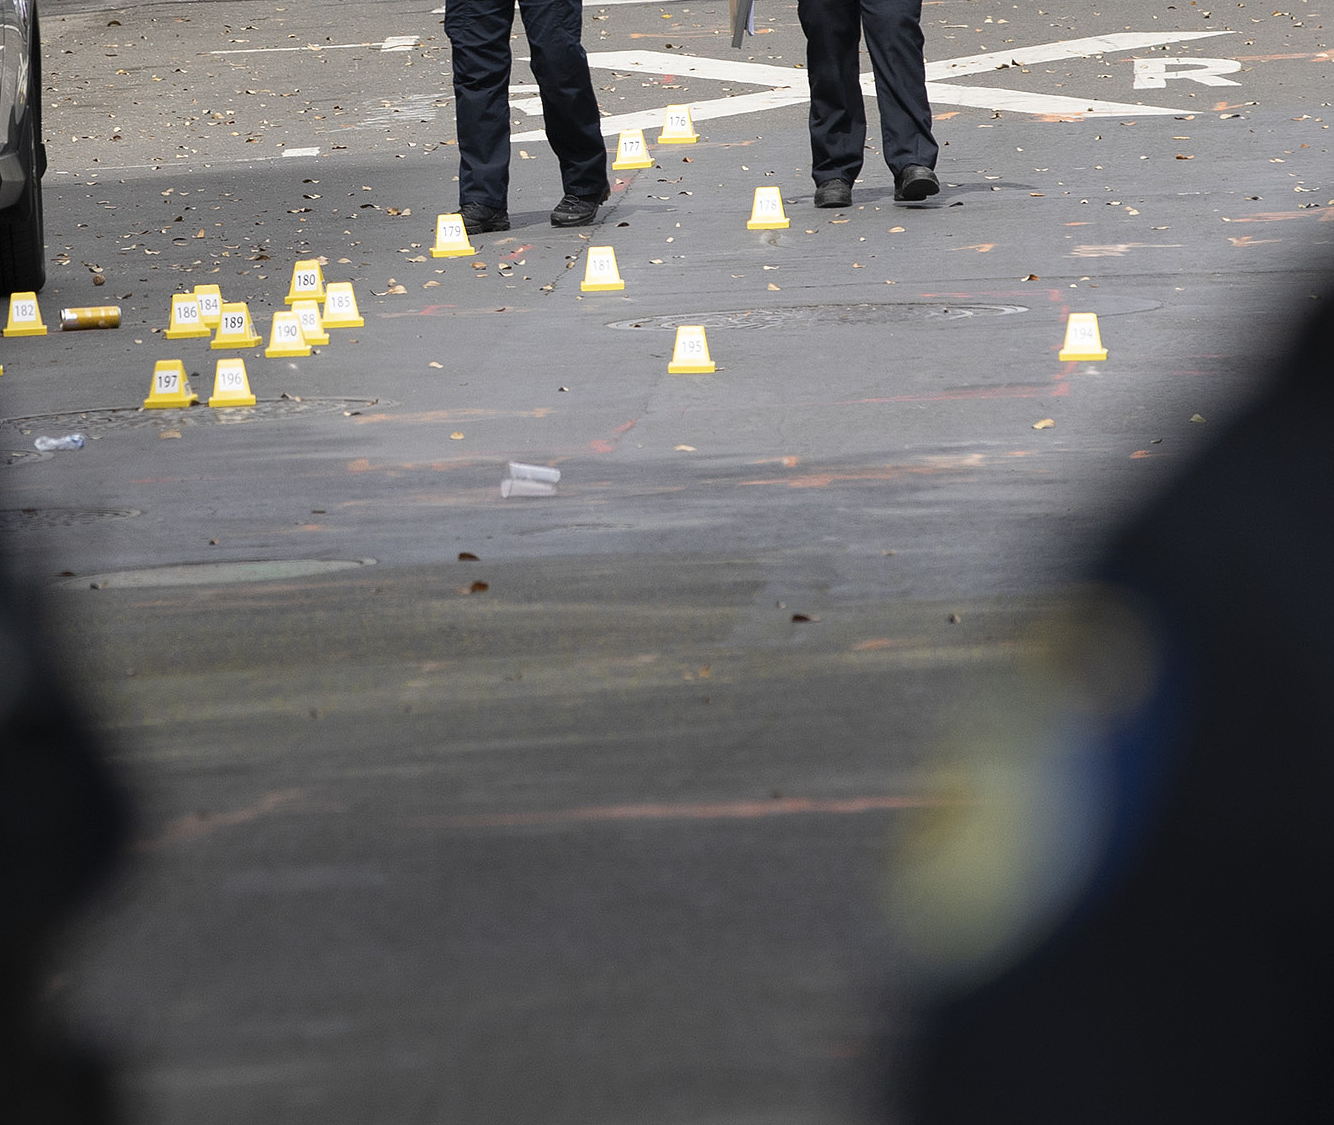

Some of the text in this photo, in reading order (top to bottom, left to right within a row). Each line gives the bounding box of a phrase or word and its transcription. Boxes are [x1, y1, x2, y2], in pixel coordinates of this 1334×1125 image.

[669, 116, 686, 127] 176
[623, 141, 640, 153] 177
[759, 199, 777, 211] 178
[443, 225, 461, 237] 179
[592, 259, 610, 272] 181
[297, 273, 316, 287] 180
[199, 298, 218, 310] 184
[331, 296, 351, 308] 185
[15, 304, 34, 317] 182
[177, 306, 197, 318] 186
[224, 316, 243, 329] 189
[302, 313, 316, 326] 88
[278, 325, 297, 337] 190
[1074, 327, 1093, 340] 194
[682, 340, 702, 353] 195
[157, 375, 177, 388] 197
[221, 373, 242, 385] 196
